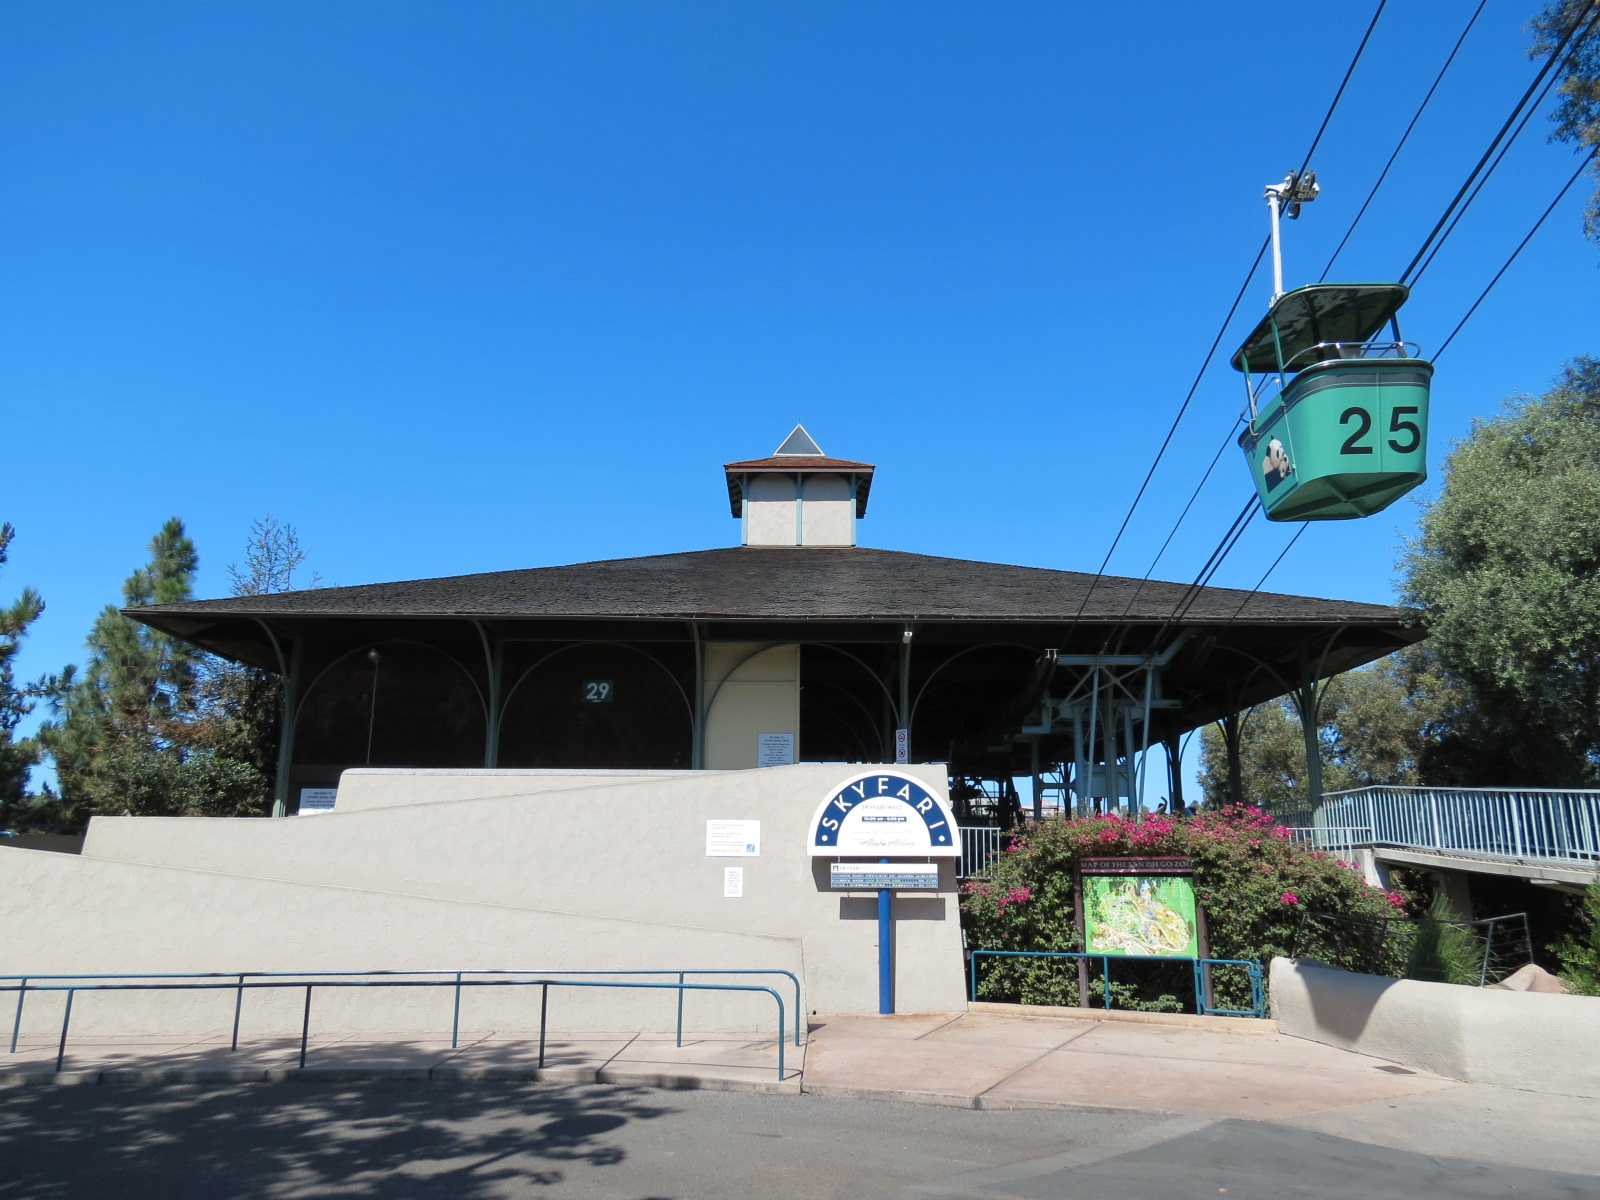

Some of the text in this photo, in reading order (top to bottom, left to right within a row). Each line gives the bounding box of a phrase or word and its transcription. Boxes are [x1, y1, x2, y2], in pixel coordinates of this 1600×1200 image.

[1339, 406, 1420, 454] 25
[586, 683, 609, 699] 29
[822, 777, 944, 831] SKYFARI
